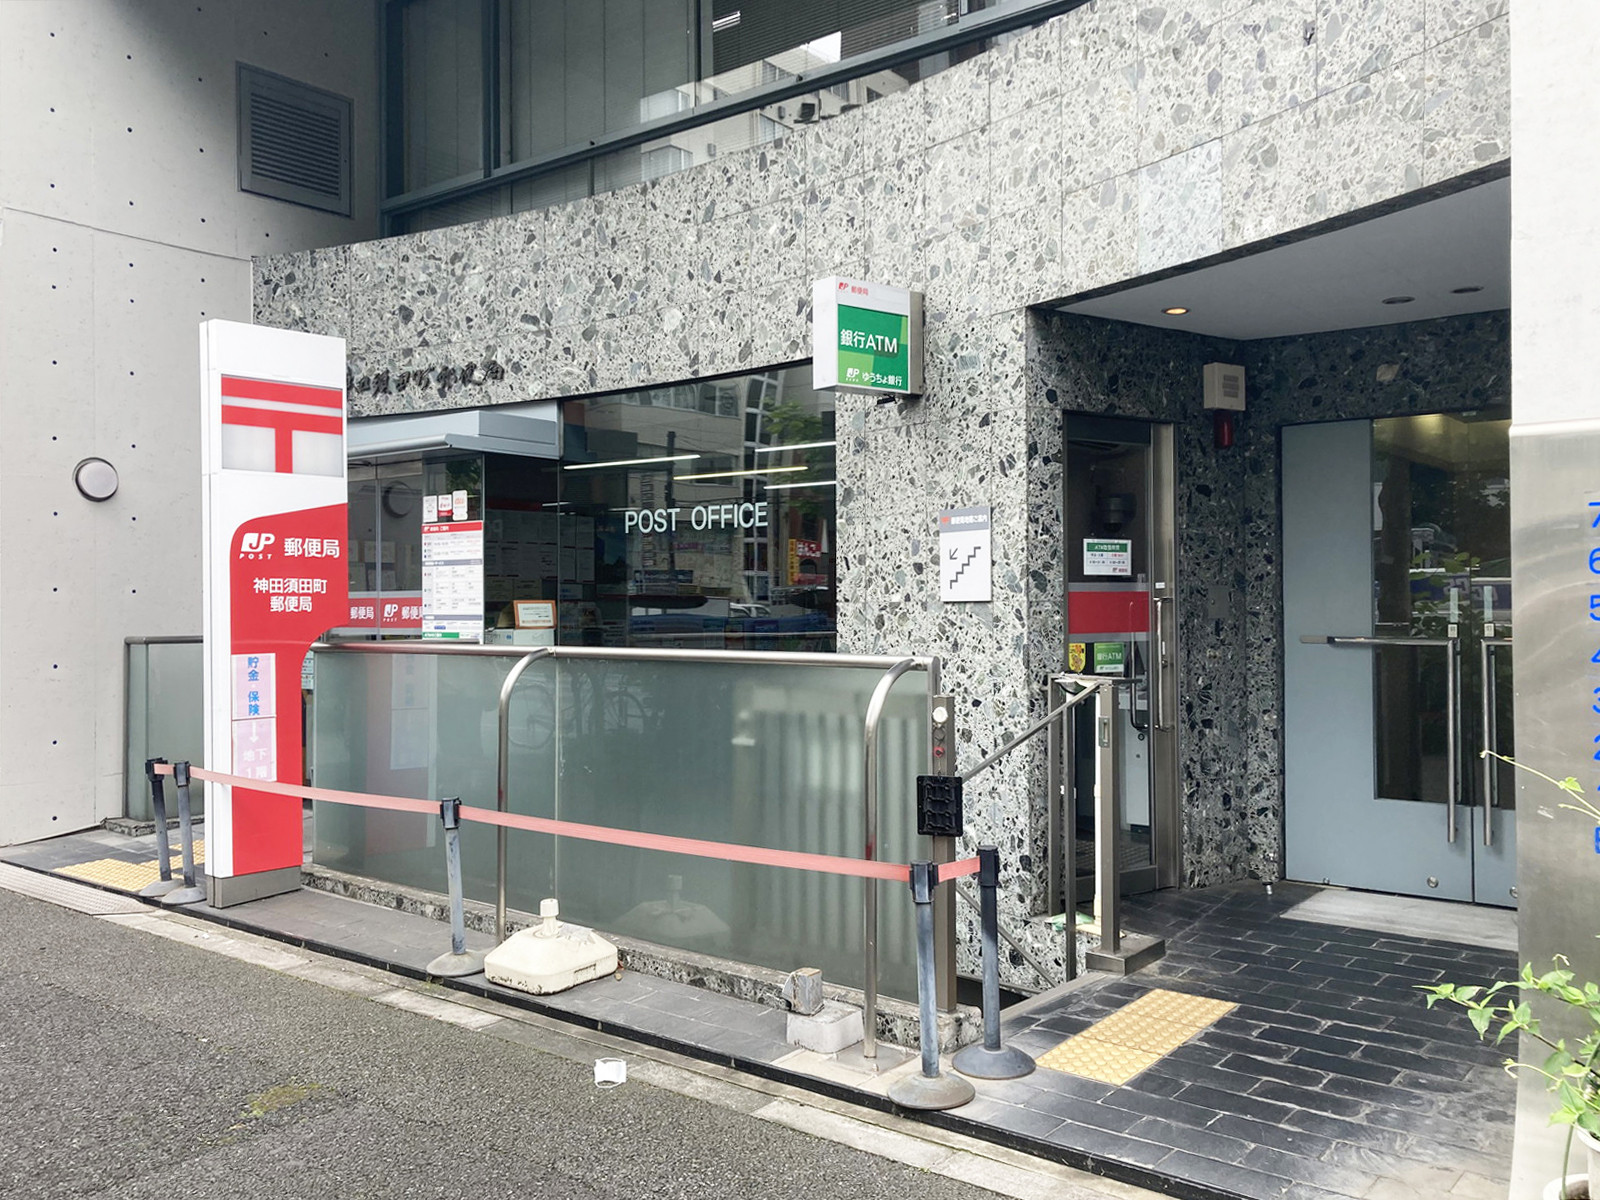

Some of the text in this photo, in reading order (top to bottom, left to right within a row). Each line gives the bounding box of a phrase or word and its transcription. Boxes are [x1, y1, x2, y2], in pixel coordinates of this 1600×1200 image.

[840, 328, 898, 353] 銀行ATM
[862, 371, 902, 387] ゆうちょ銀行
[625, 502, 768, 533] POST OFFICE
[241, 532, 340, 558] JP 郵便局
[253, 577, 328, 594] 神田須田町
[270, 595, 313, 613] 郵便局
[350, 606, 374, 620] 郵便局
